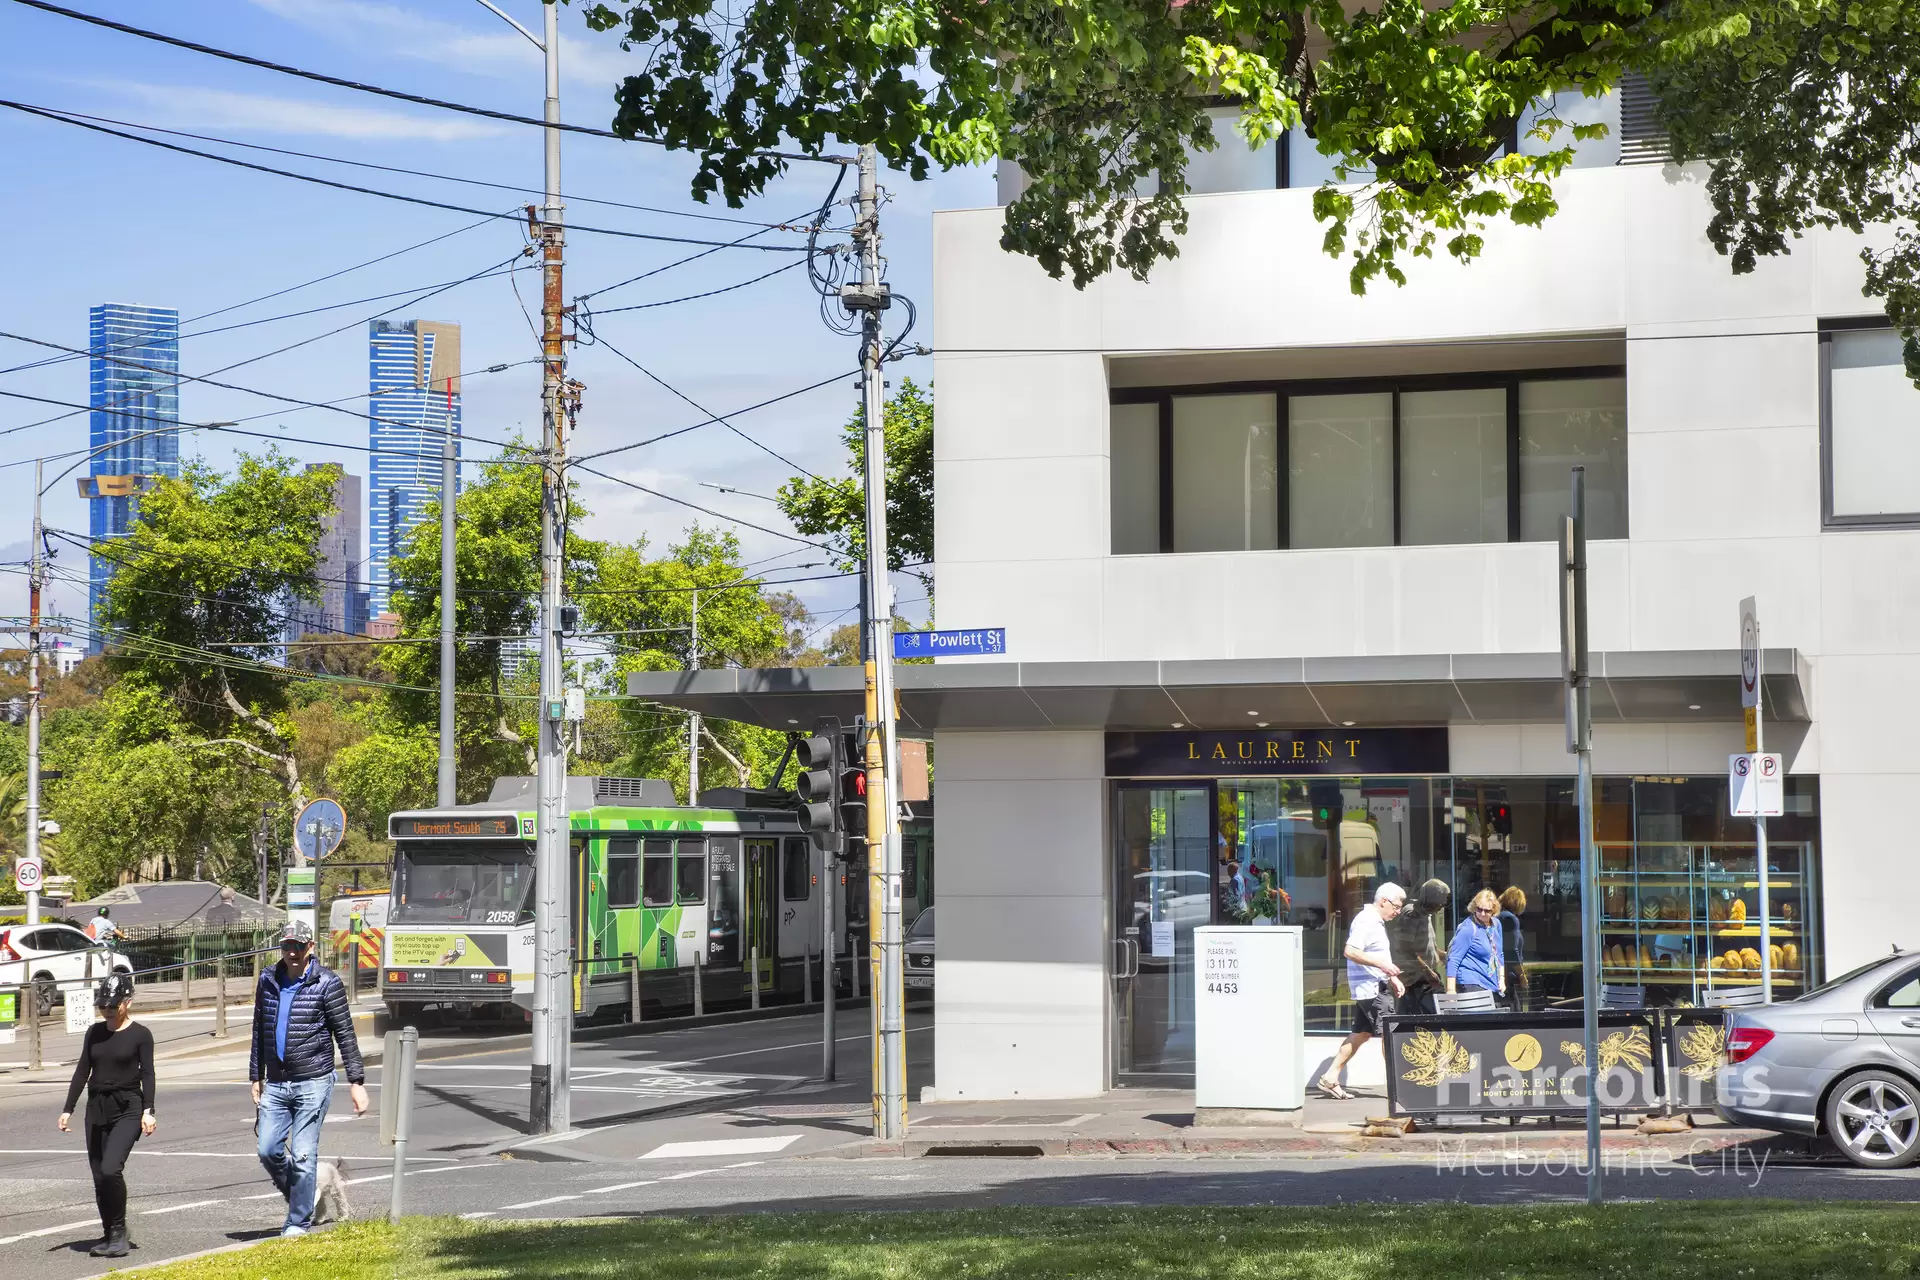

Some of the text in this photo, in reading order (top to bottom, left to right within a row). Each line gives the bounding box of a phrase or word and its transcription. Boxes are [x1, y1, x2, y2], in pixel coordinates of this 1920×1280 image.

[930, 630, 1001, 647] Powlett St
[1743, 634, 1755, 668] 40
[1188, 740, 1360, 759] LAURENT
[1738, 759, 1747, 774] S
[1764, 759, 1773, 775] P
[413, 821, 506, 834] Vermont South 75
[715, 846, 725, 854] FULLY
[711, 855, 731, 863] INTEGRATED
[711, 863, 721, 871] POINT
[726, 863, 735, 871] SALE
[20, 867, 37, 880] 60
[486, 911, 516, 923] 2058
[1206, 959, 1239, 969] 13 11 70
[1207, 982, 1238, 994] 4453
[70, 993, 90, 1004] WATCH
[74, 1005, 86, 1016] FOR
[71, 1017, 91, 1029] TRAMS
[1483, 1077, 1568, 1089] LAURENT
